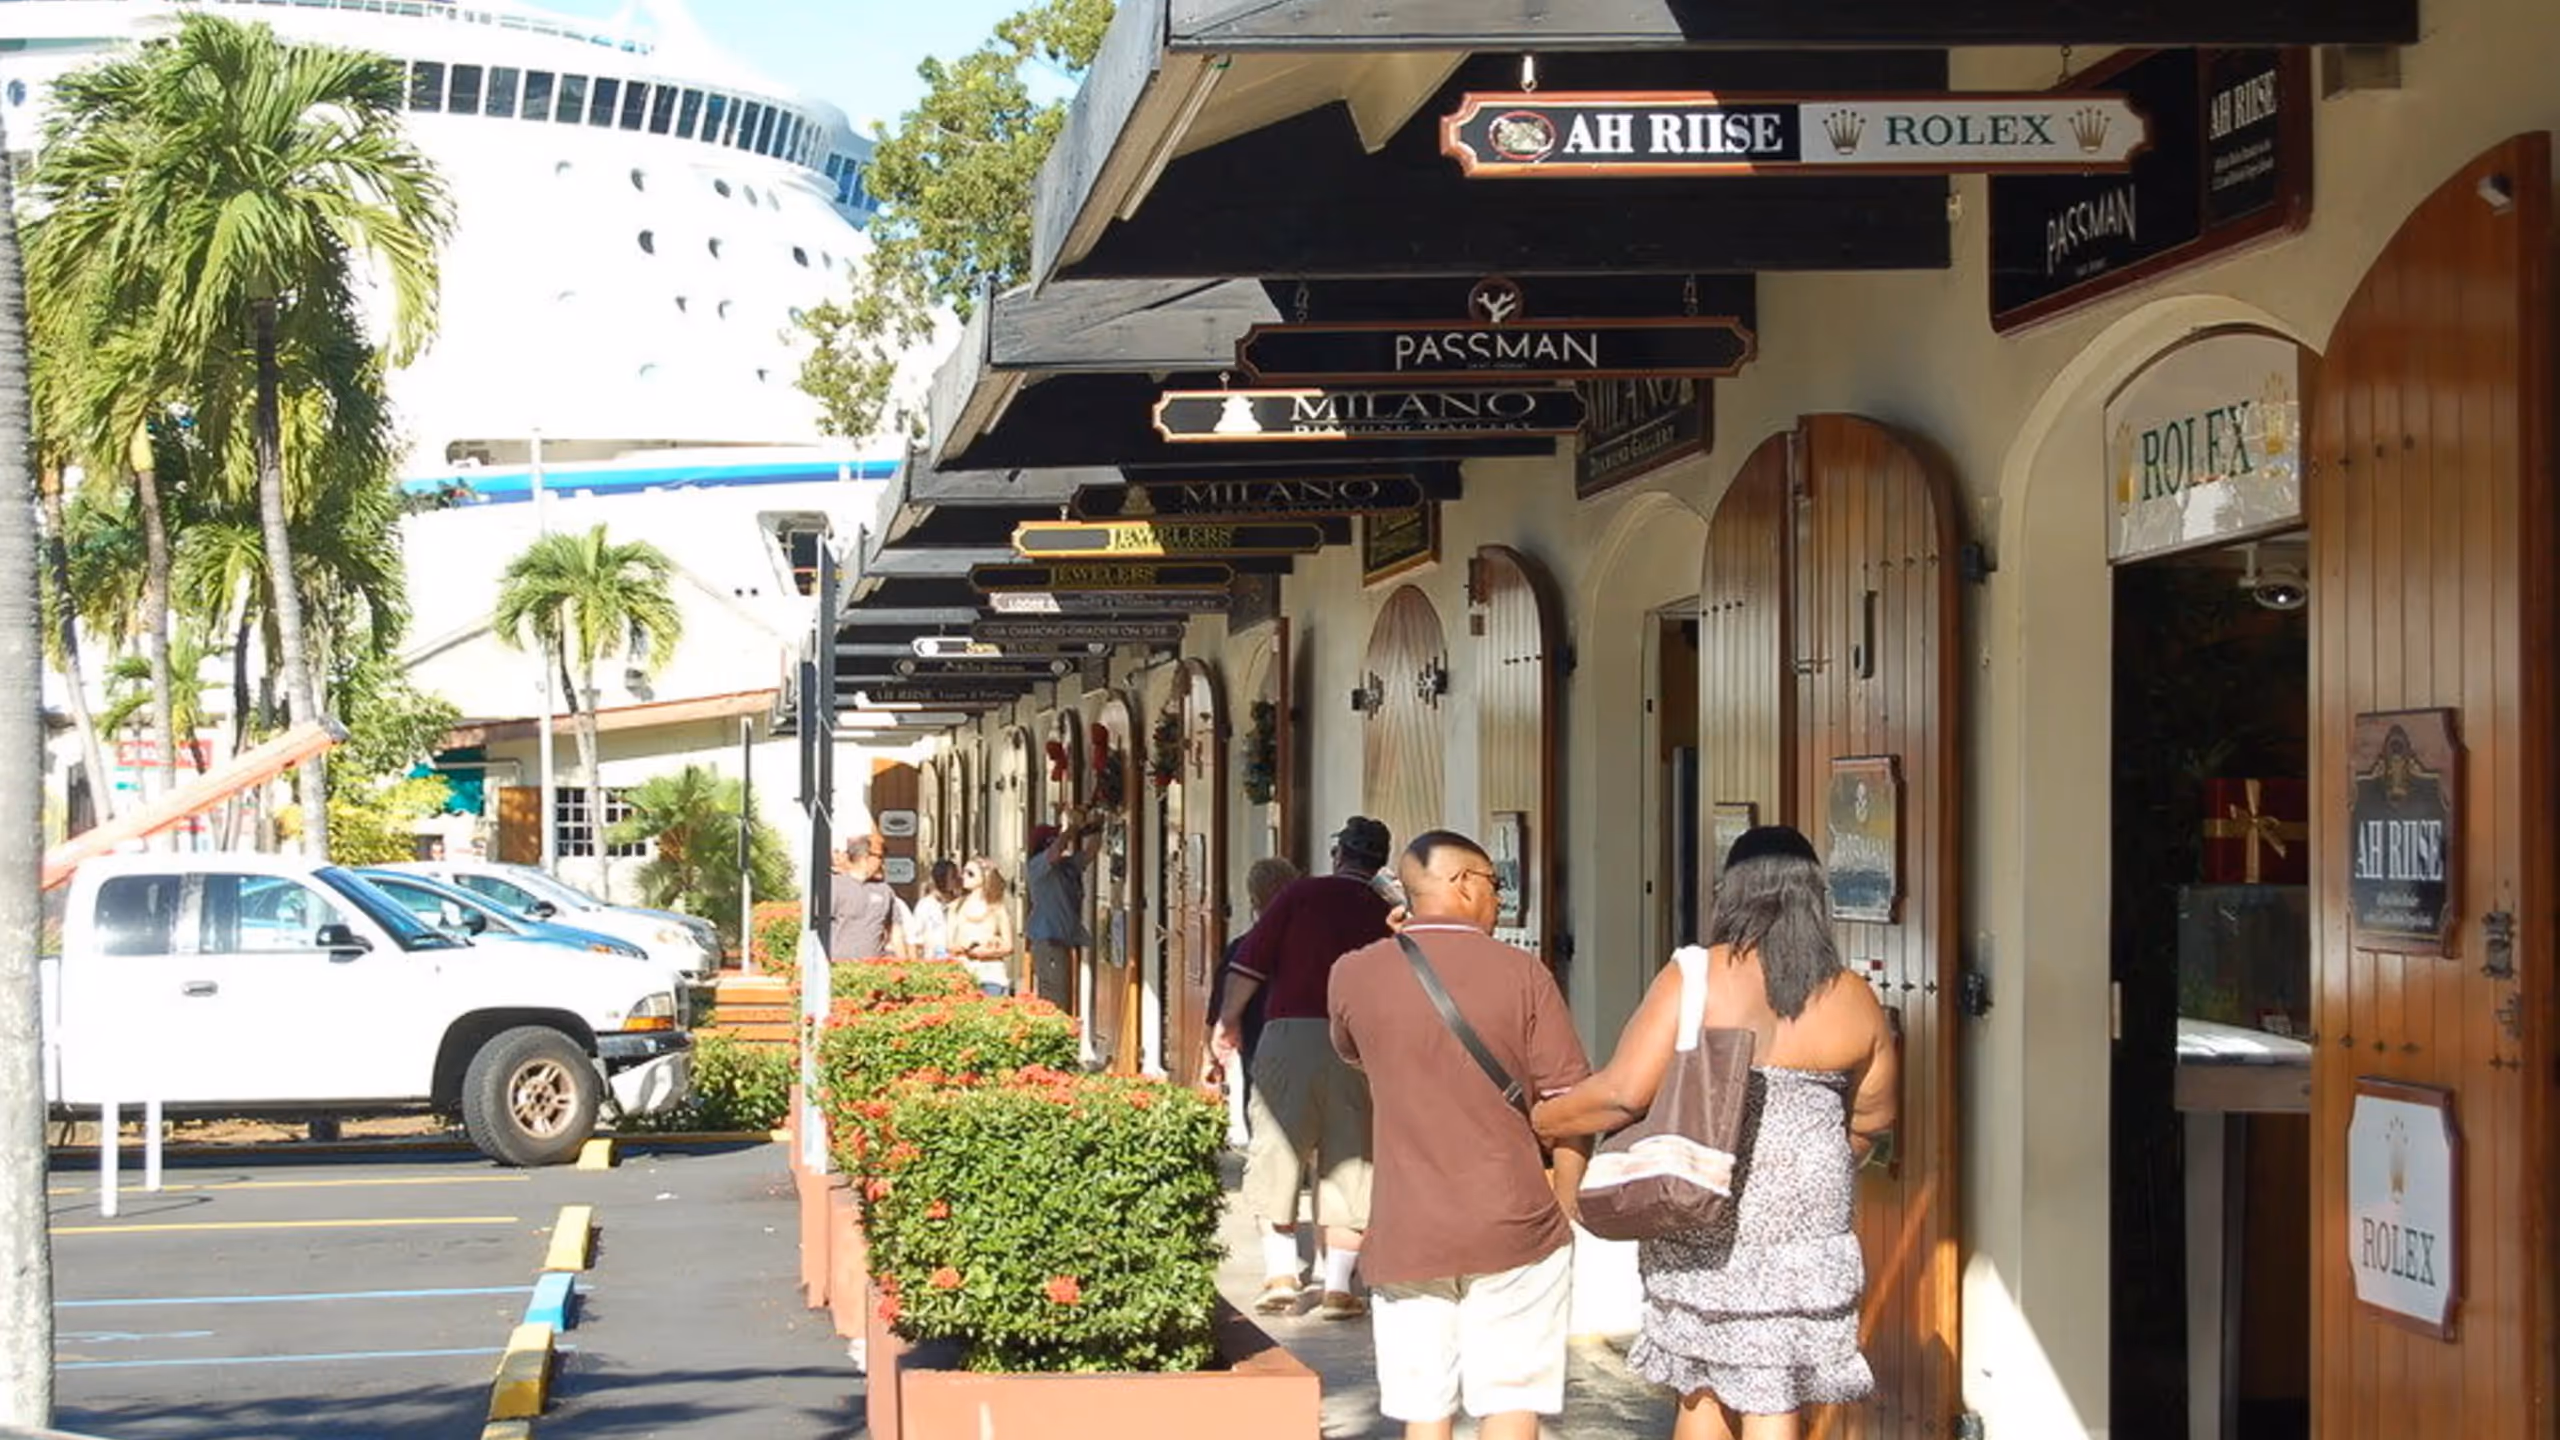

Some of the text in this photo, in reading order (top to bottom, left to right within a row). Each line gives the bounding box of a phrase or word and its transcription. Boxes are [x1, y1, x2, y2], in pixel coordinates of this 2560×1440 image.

[1563, 113, 1783, 153] AH RIISE
[1886, 115, 2056, 147] ROLEX
[2047, 184, 2136, 276] PASSMAN
[1395, 332, 1597, 370] PASSMAN
[1290, 392, 1537, 422] MILANO
[2142, 401, 2253, 502] ROLEX
[2355, 819, 2443, 881] AH RIISE
[2362, 1217, 2436, 1287] ROLEX
